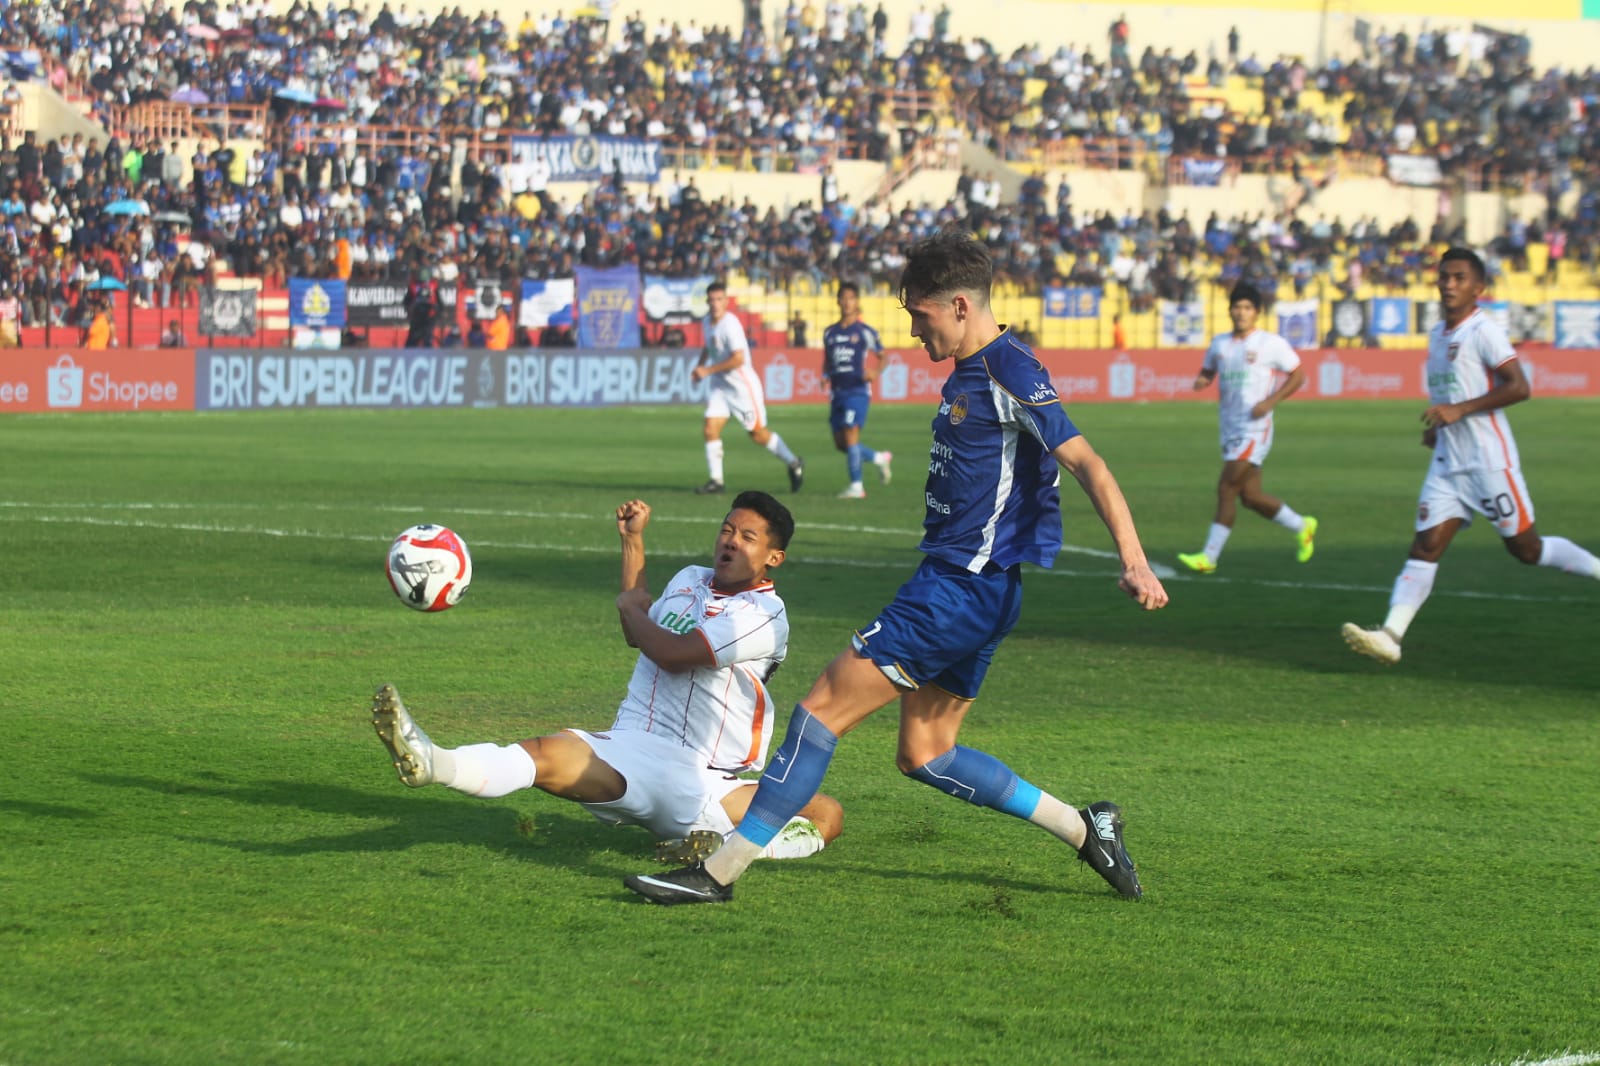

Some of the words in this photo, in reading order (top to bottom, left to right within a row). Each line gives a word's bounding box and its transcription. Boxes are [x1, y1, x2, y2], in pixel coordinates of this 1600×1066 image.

[89, 371, 178, 408] Shopee
[210, 355, 253, 407] BRI
[258, 356, 356, 405] SUPER
[356, 356, 469, 405] LEAGUE
[505, 355, 547, 405] BRI
[1481, 493, 1515, 521] 50
[862, 620, 882, 639] 7
